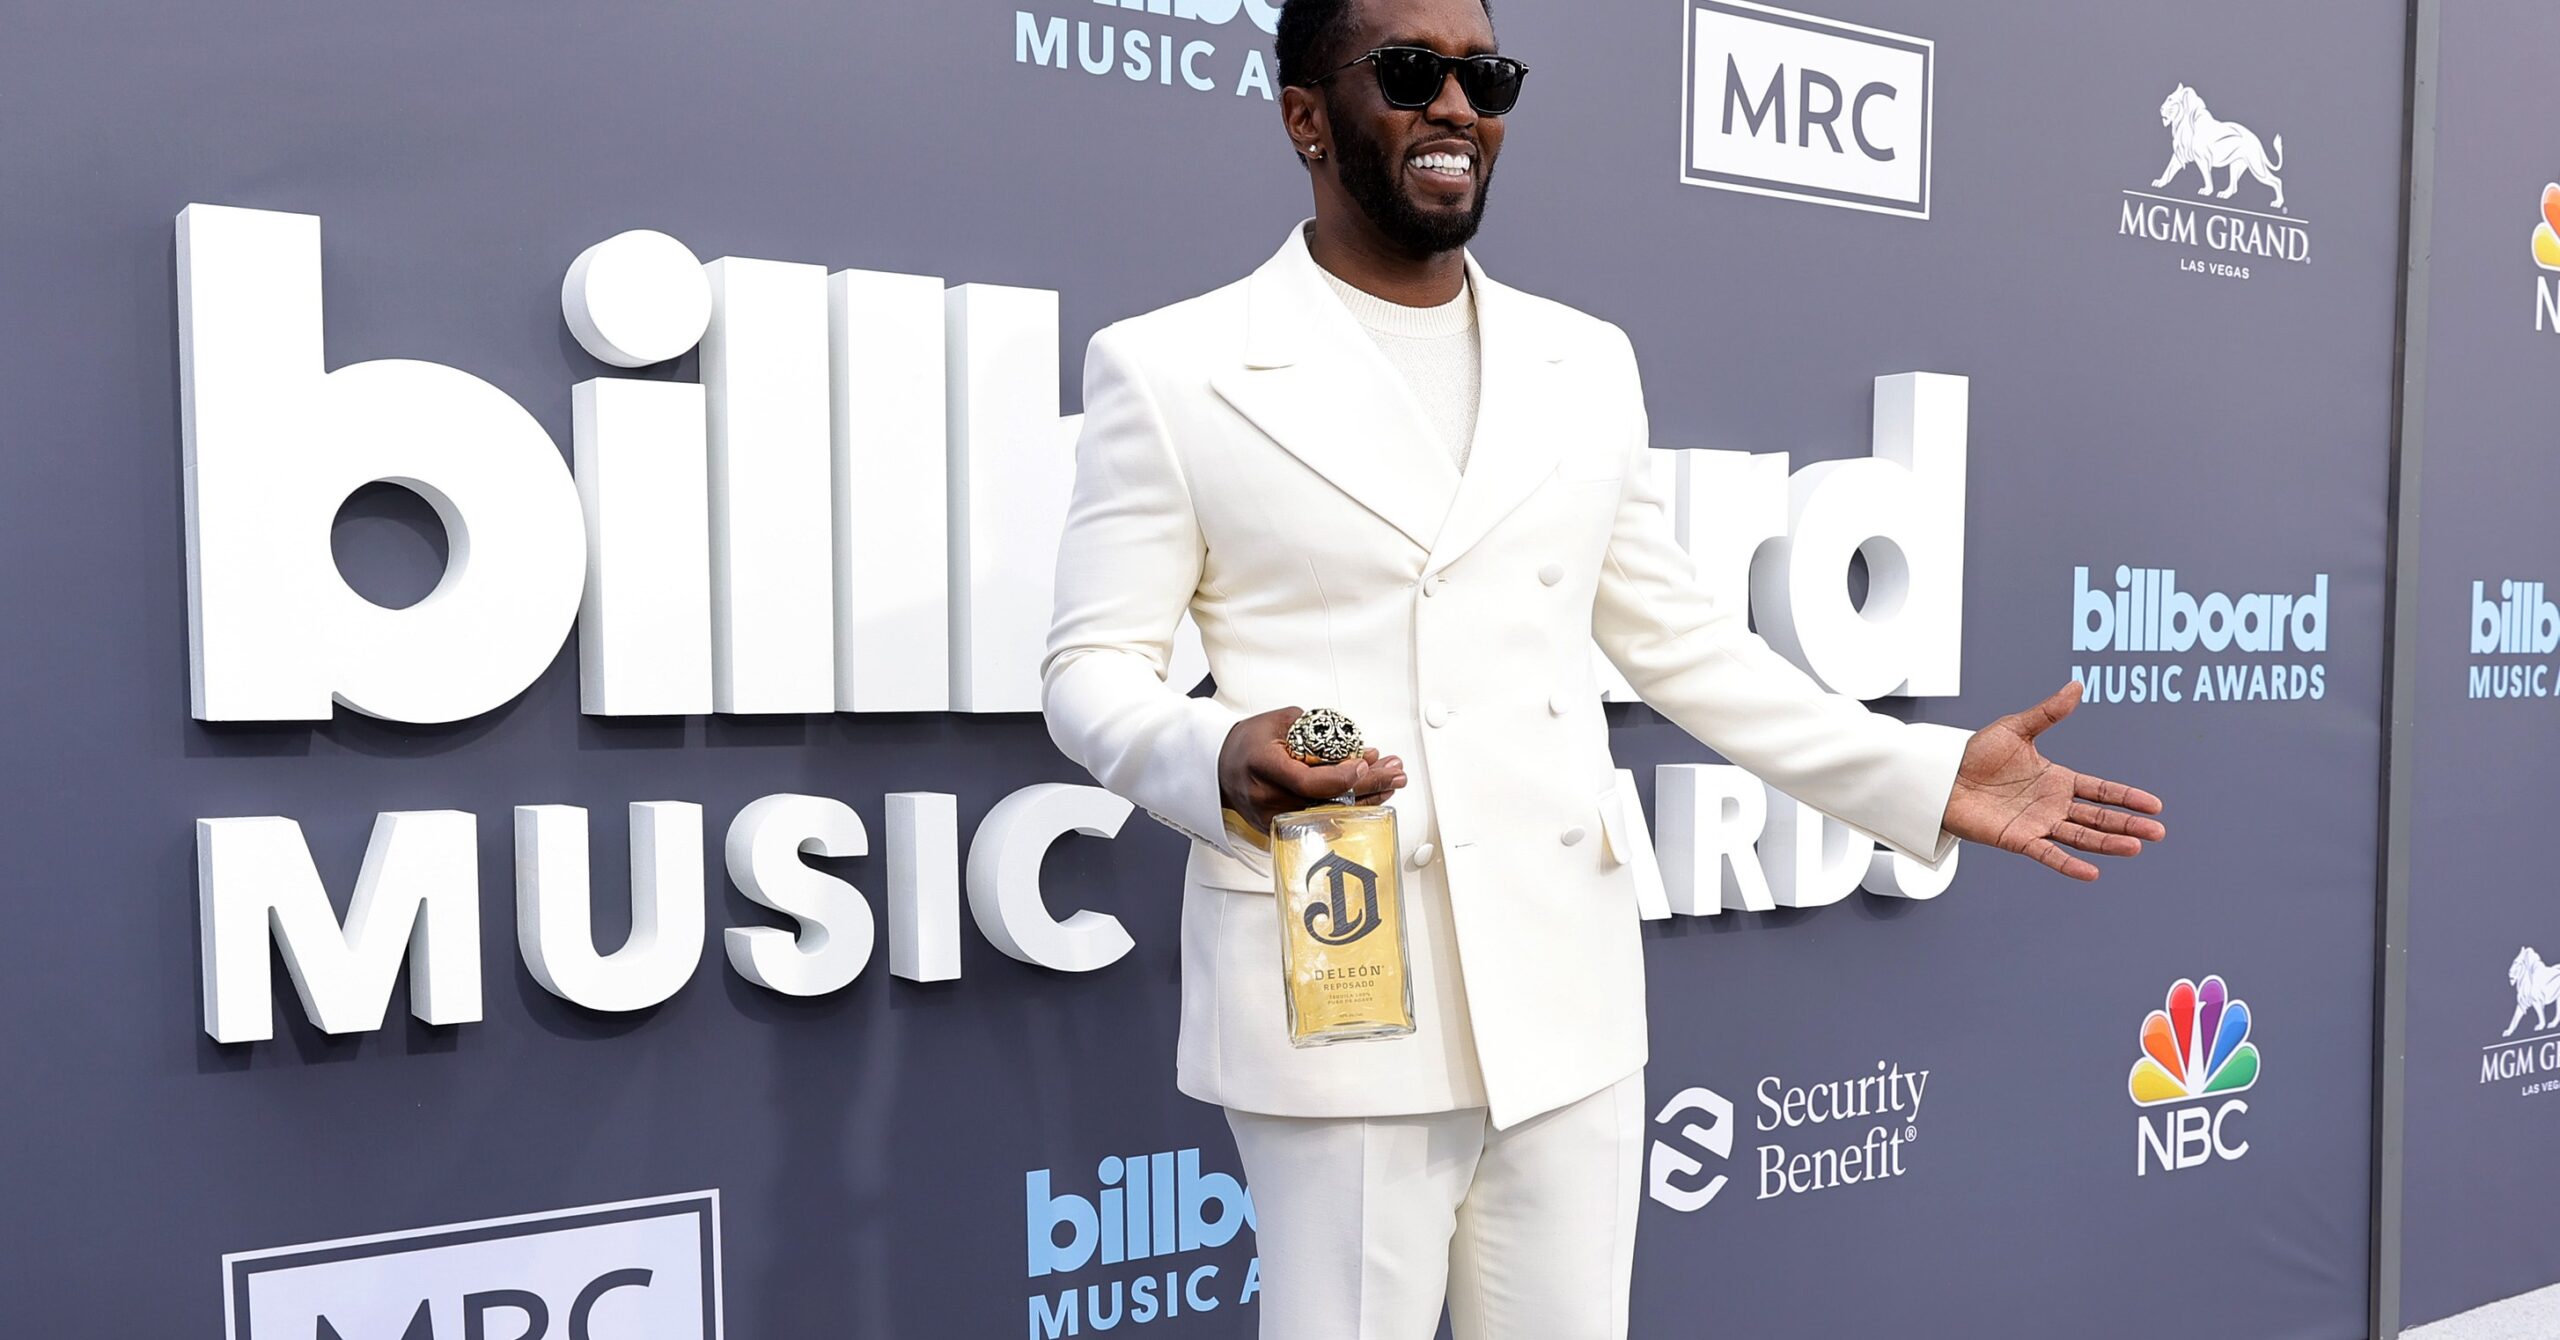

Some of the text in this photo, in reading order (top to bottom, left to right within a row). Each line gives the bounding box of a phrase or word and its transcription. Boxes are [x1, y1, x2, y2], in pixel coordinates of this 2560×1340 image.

[1015, 10, 1216, 92] MUSIC
[1721, 52, 1897, 162] MRC
[2119, 199, 2310, 262] MGM GRAND
[2180, 258, 2250, 280] LAS VEGAS
[2072, 564, 2329, 652] billboard
[2470, 578, 2560, 654] billb
[2071, 664, 2326, 703] MUSIC AWARDS
[2469, 664, 2548, 698] MUSIC
[196, 783, 1137, 1044] MUSIC
[1323, 980, 1375, 991] REPOSADO
[1756, 1060, 1930, 1123] Security
[2480, 1045, 2535, 1084] MGM
[2522, 1079, 2560, 1097] LAS VEG
[2137, 1099, 2250, 1177] NBC
[1026, 1147, 1258, 1278] billb
[1028, 1264, 1220, 1340] MUSIC
